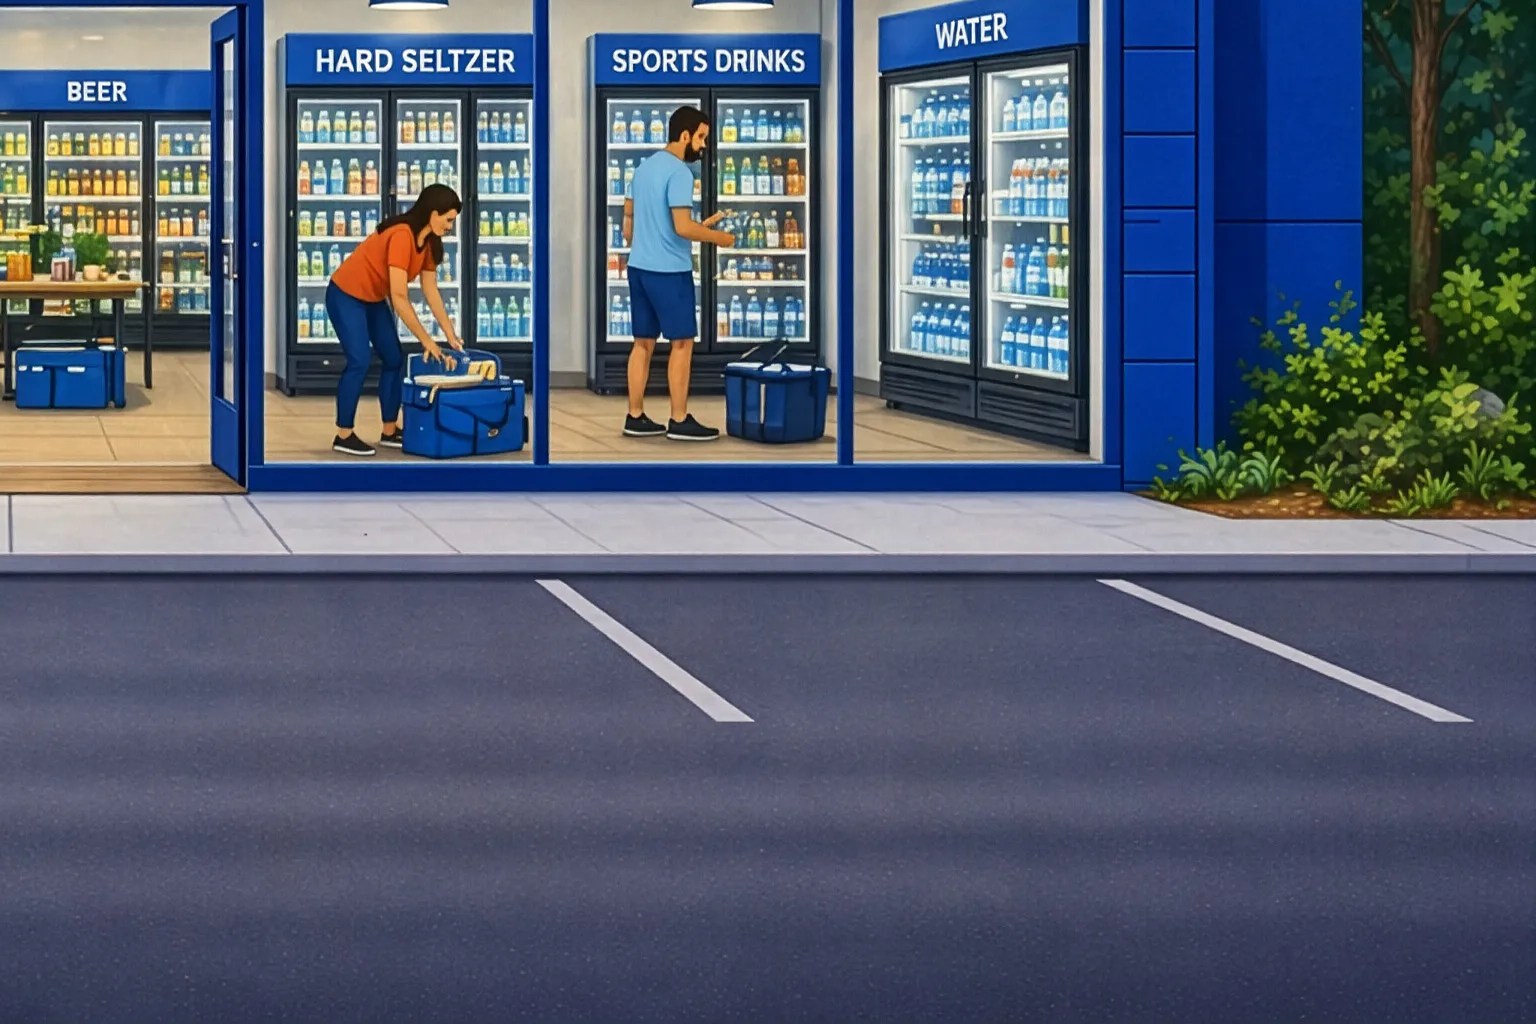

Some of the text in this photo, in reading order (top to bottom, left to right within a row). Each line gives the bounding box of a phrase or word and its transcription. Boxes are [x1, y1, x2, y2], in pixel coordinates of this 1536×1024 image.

[935, 12, 1009, 50] WATER
[316, 48, 515, 73] HARD SELTZER
[612, 49, 805, 73] SPORTS DRINKS
[67, 81, 128, 102] BEER
